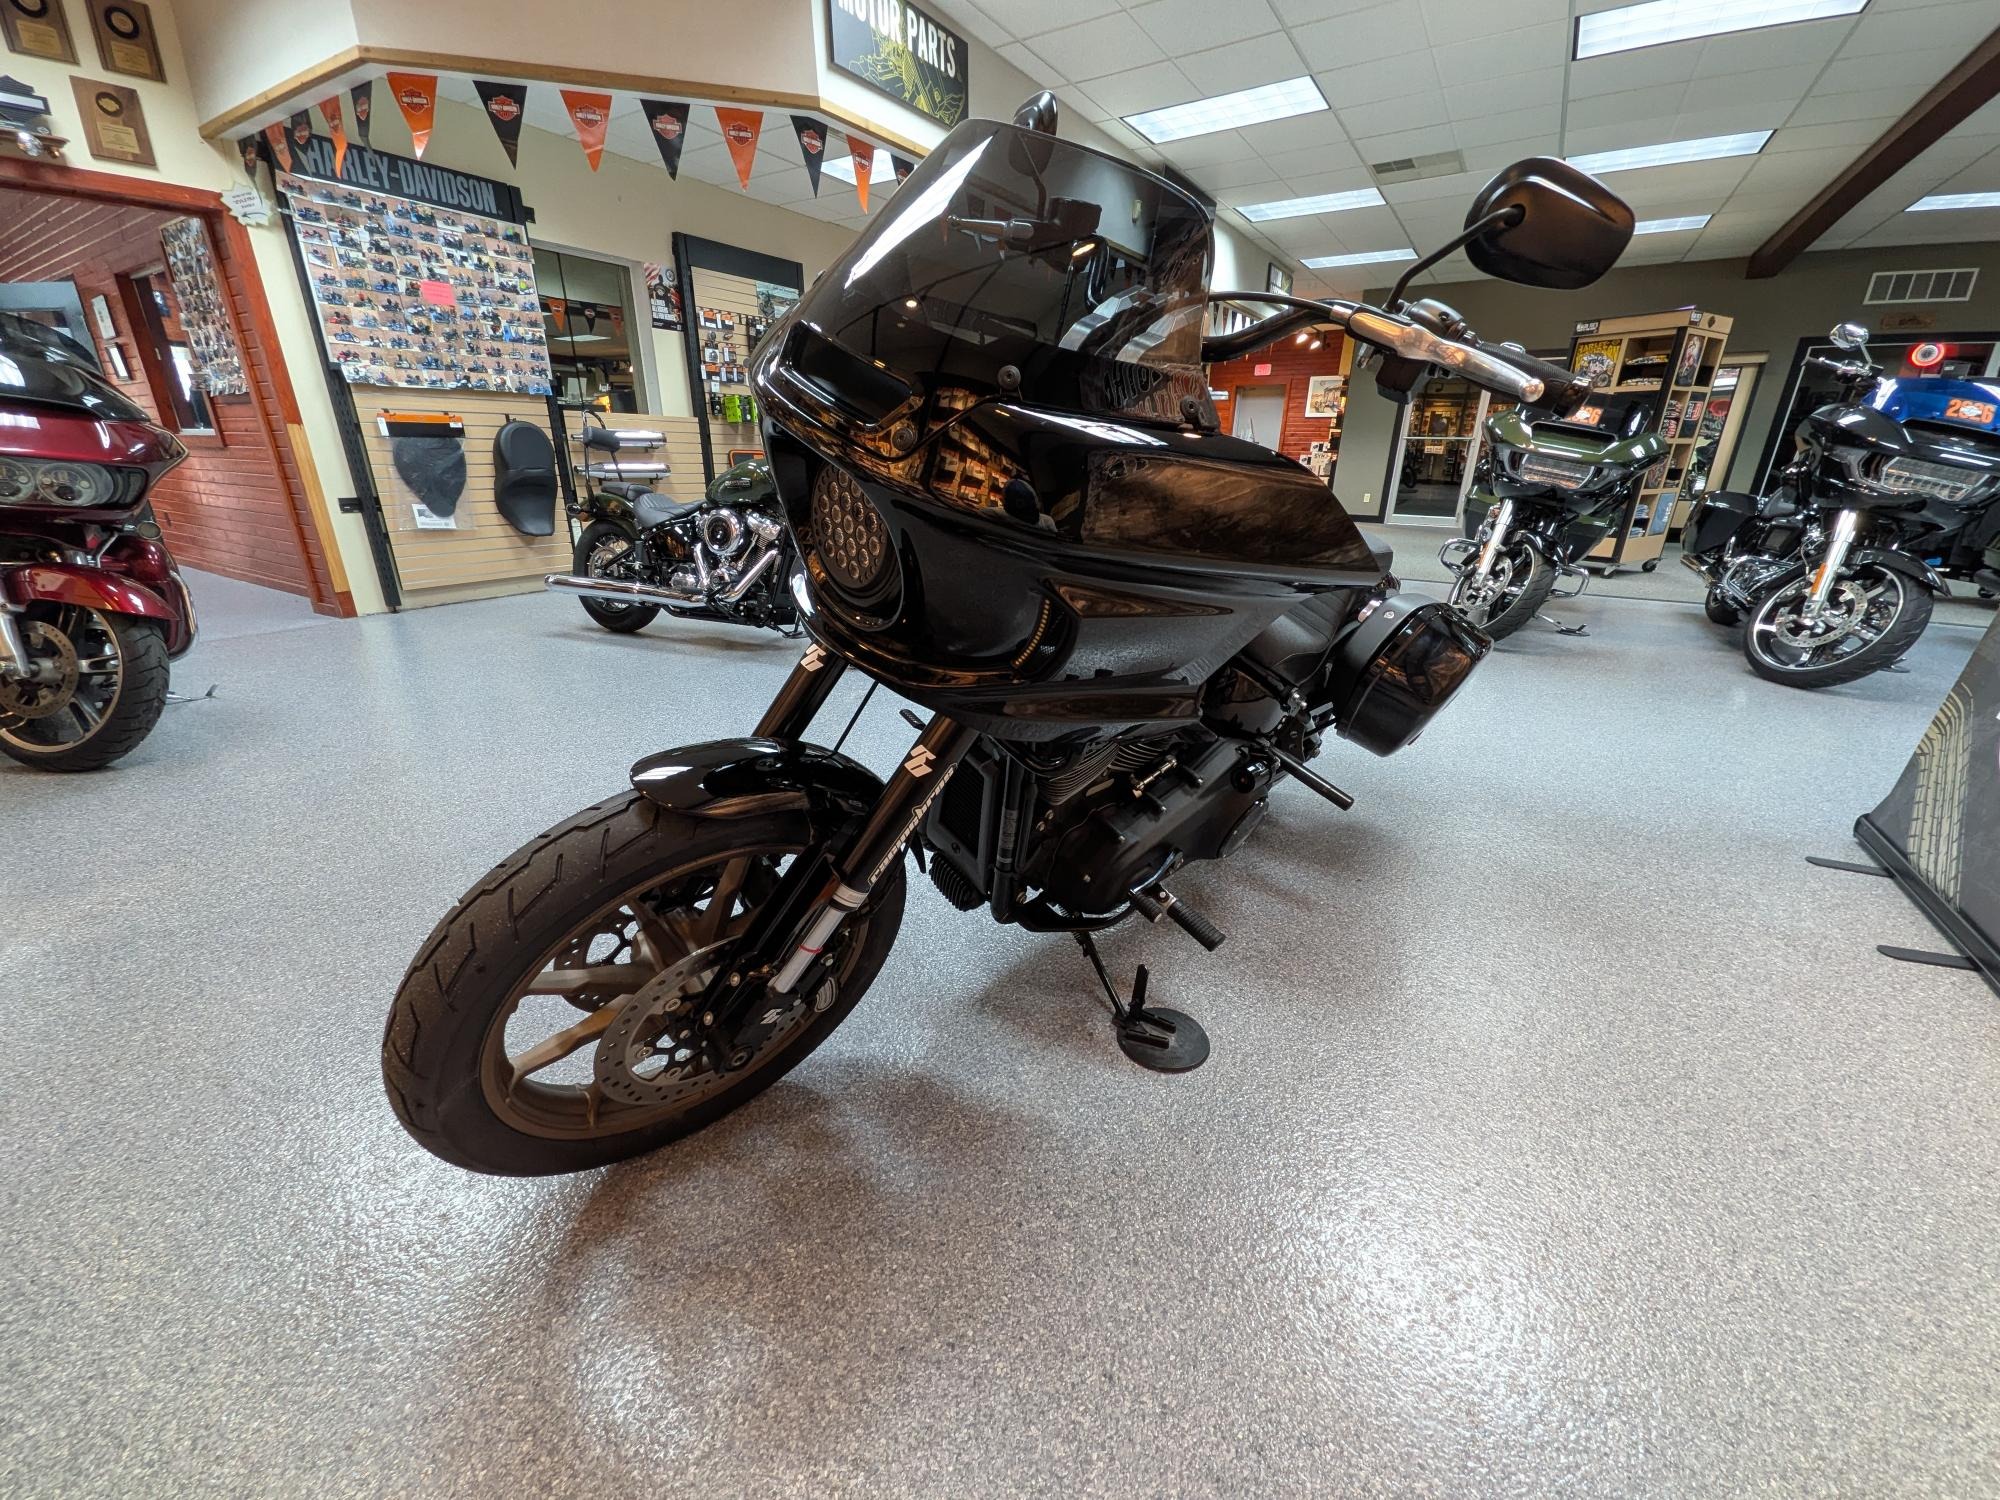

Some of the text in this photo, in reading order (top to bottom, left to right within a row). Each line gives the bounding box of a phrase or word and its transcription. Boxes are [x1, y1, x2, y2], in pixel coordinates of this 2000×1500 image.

[838, 0, 956, 78] TOR PARTS
[307, 138, 499, 215] HARLEY-DAVIDSON
